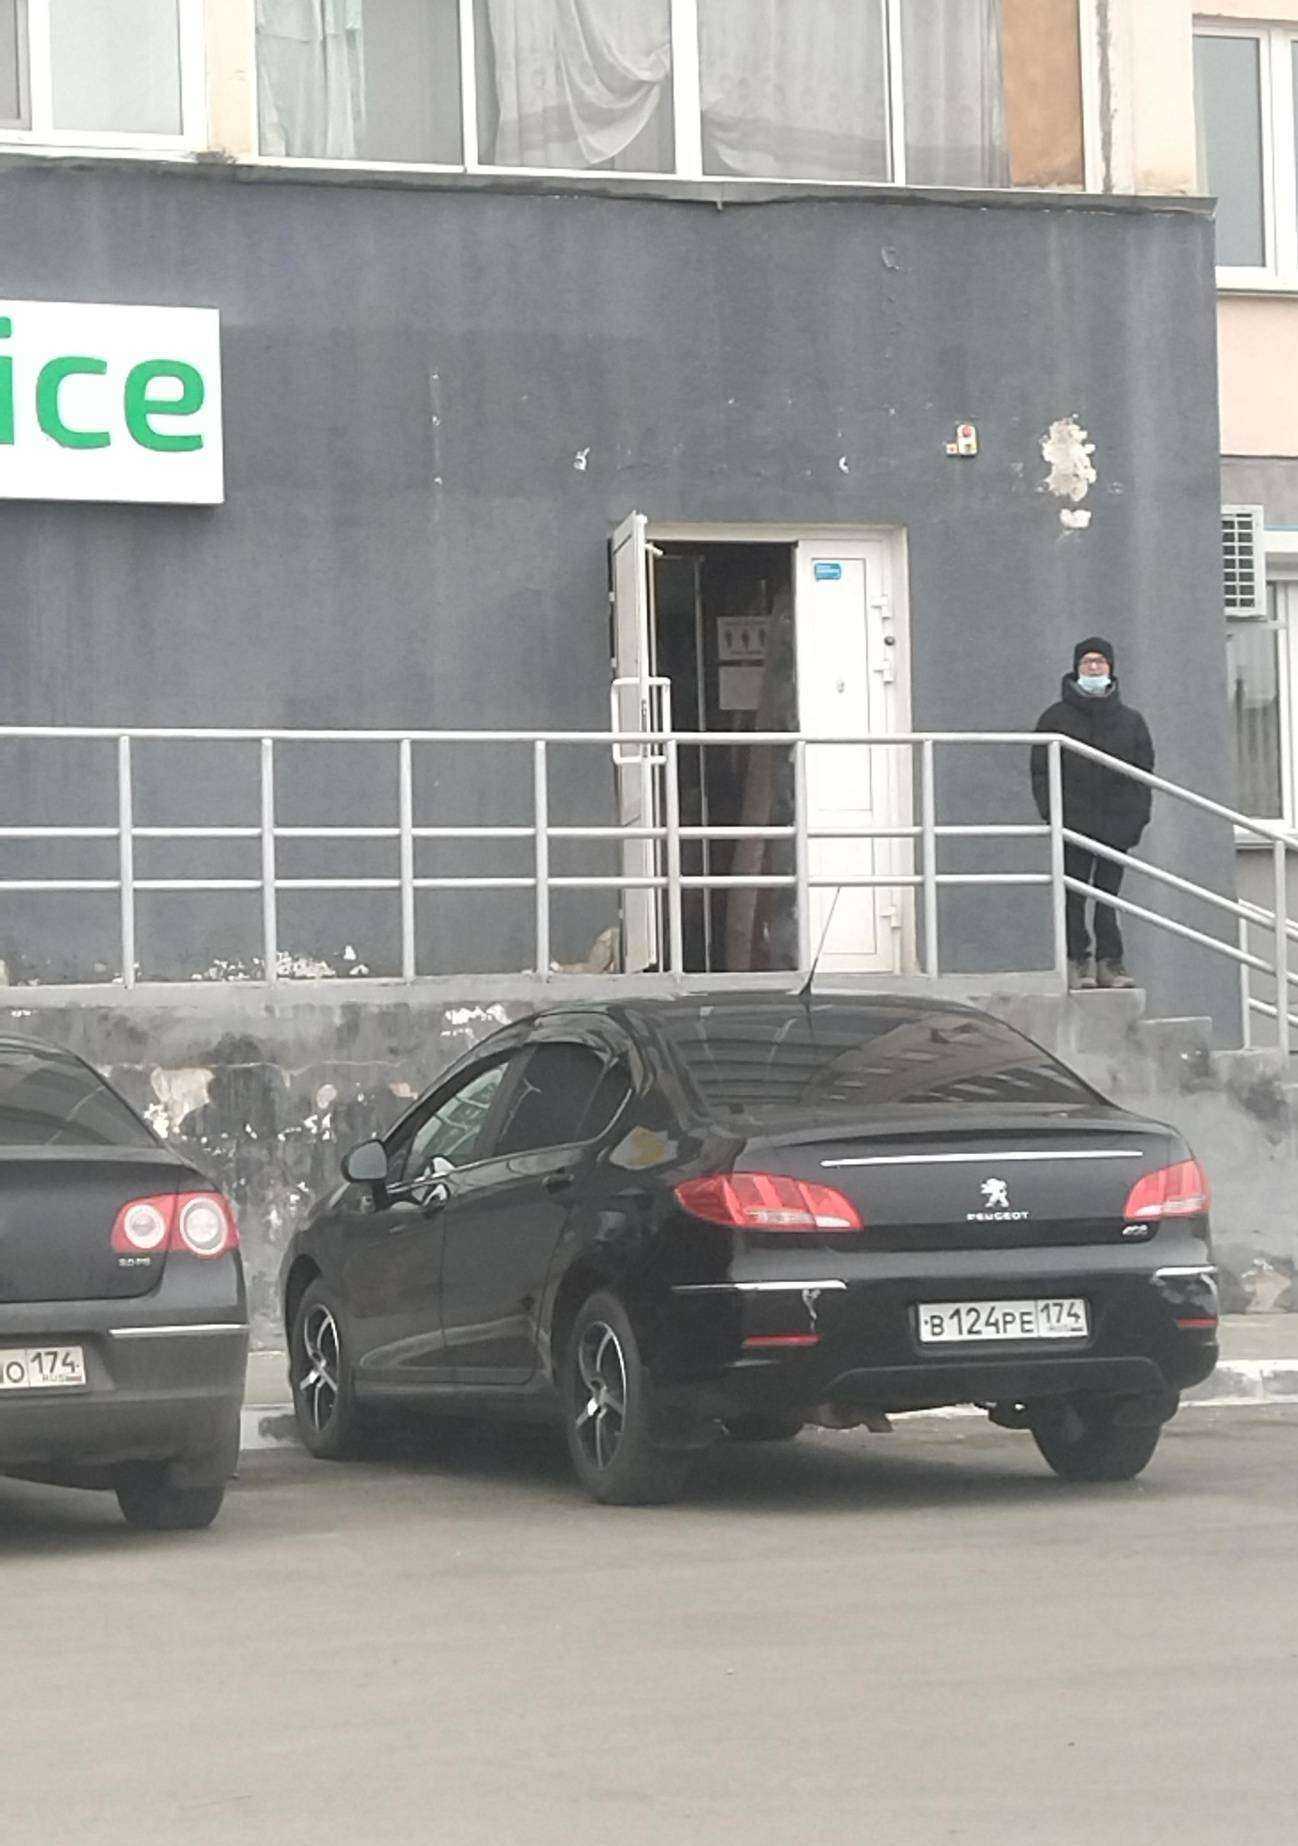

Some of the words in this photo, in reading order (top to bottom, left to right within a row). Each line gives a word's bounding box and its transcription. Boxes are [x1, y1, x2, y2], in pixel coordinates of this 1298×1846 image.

[966, 1211, 1030, 1222] PEUGEOT
[1040, 1302, 1081, 1324] 174
[30, 1351, 75, 1374] 174
